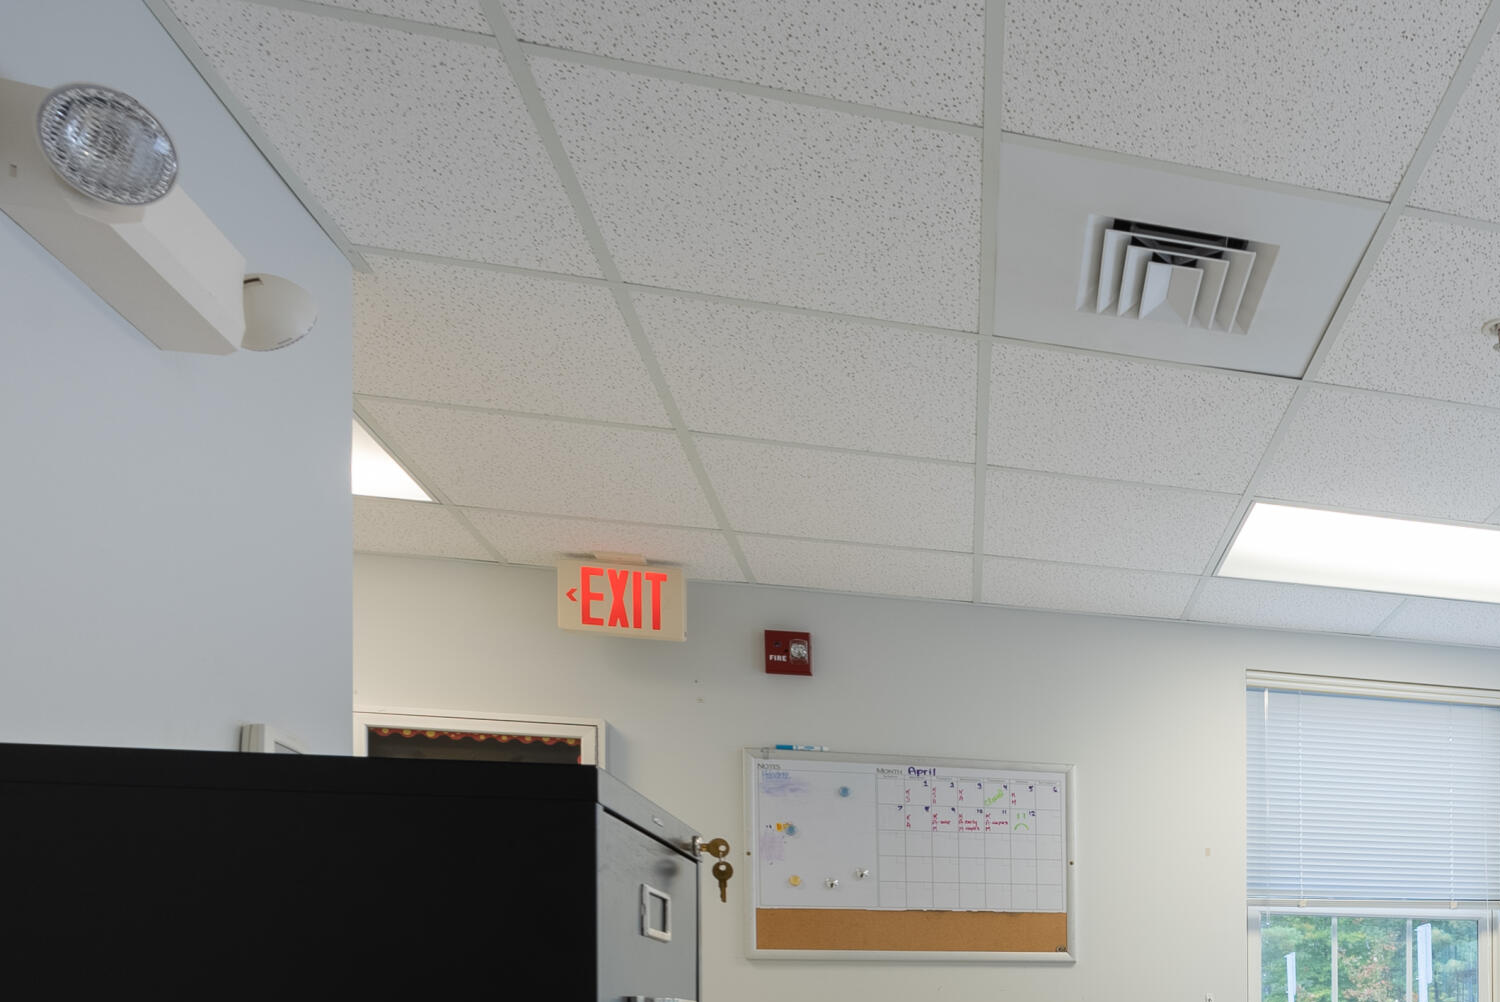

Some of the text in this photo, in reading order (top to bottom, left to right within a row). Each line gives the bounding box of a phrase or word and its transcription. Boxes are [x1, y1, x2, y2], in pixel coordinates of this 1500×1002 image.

[580, 565, 668, 631] EXIT
[769, 654, 788, 662] FIRE
[876, 767, 903, 775] MONTH
[907, 766, 936, 776] April
